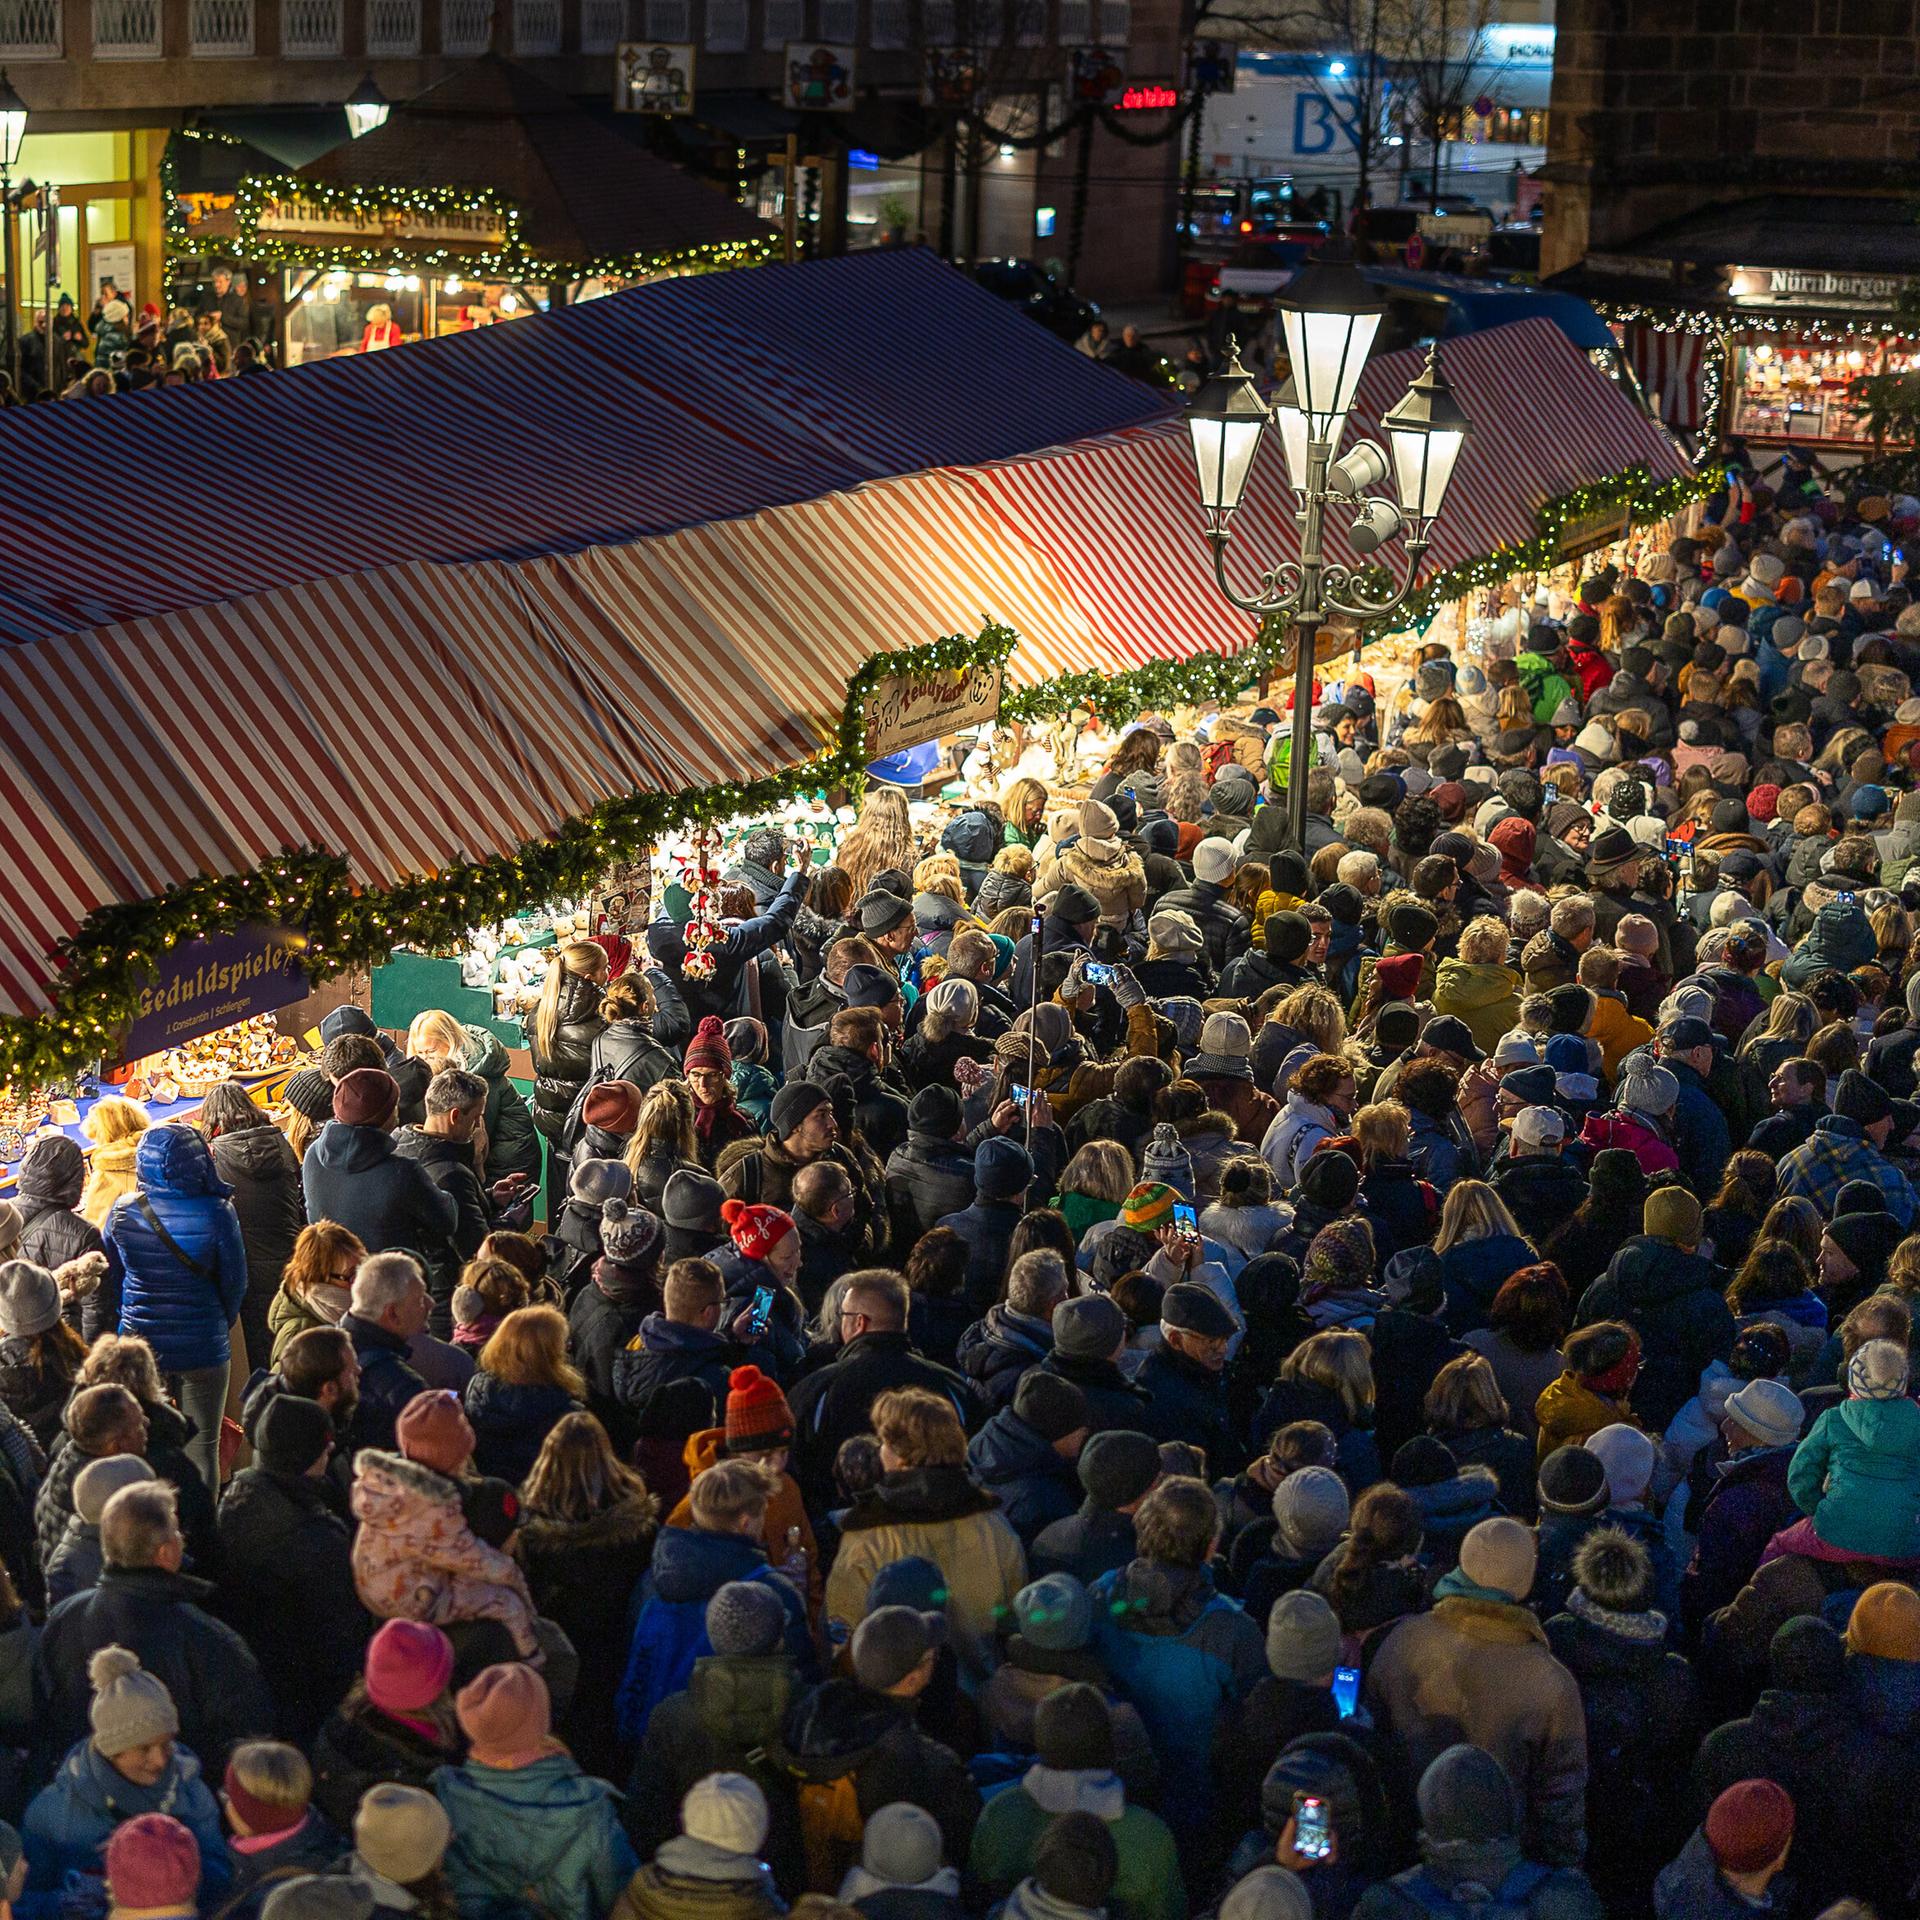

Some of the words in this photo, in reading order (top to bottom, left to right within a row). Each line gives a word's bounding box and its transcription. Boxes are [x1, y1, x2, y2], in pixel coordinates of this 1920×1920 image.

[1770, 270, 1897, 299] Nürnberger
[901, 670, 970, 712] Teddyland
[139, 943, 282, 1018] Geduldspiele
[172, 1009, 209, 1032] Constantin
